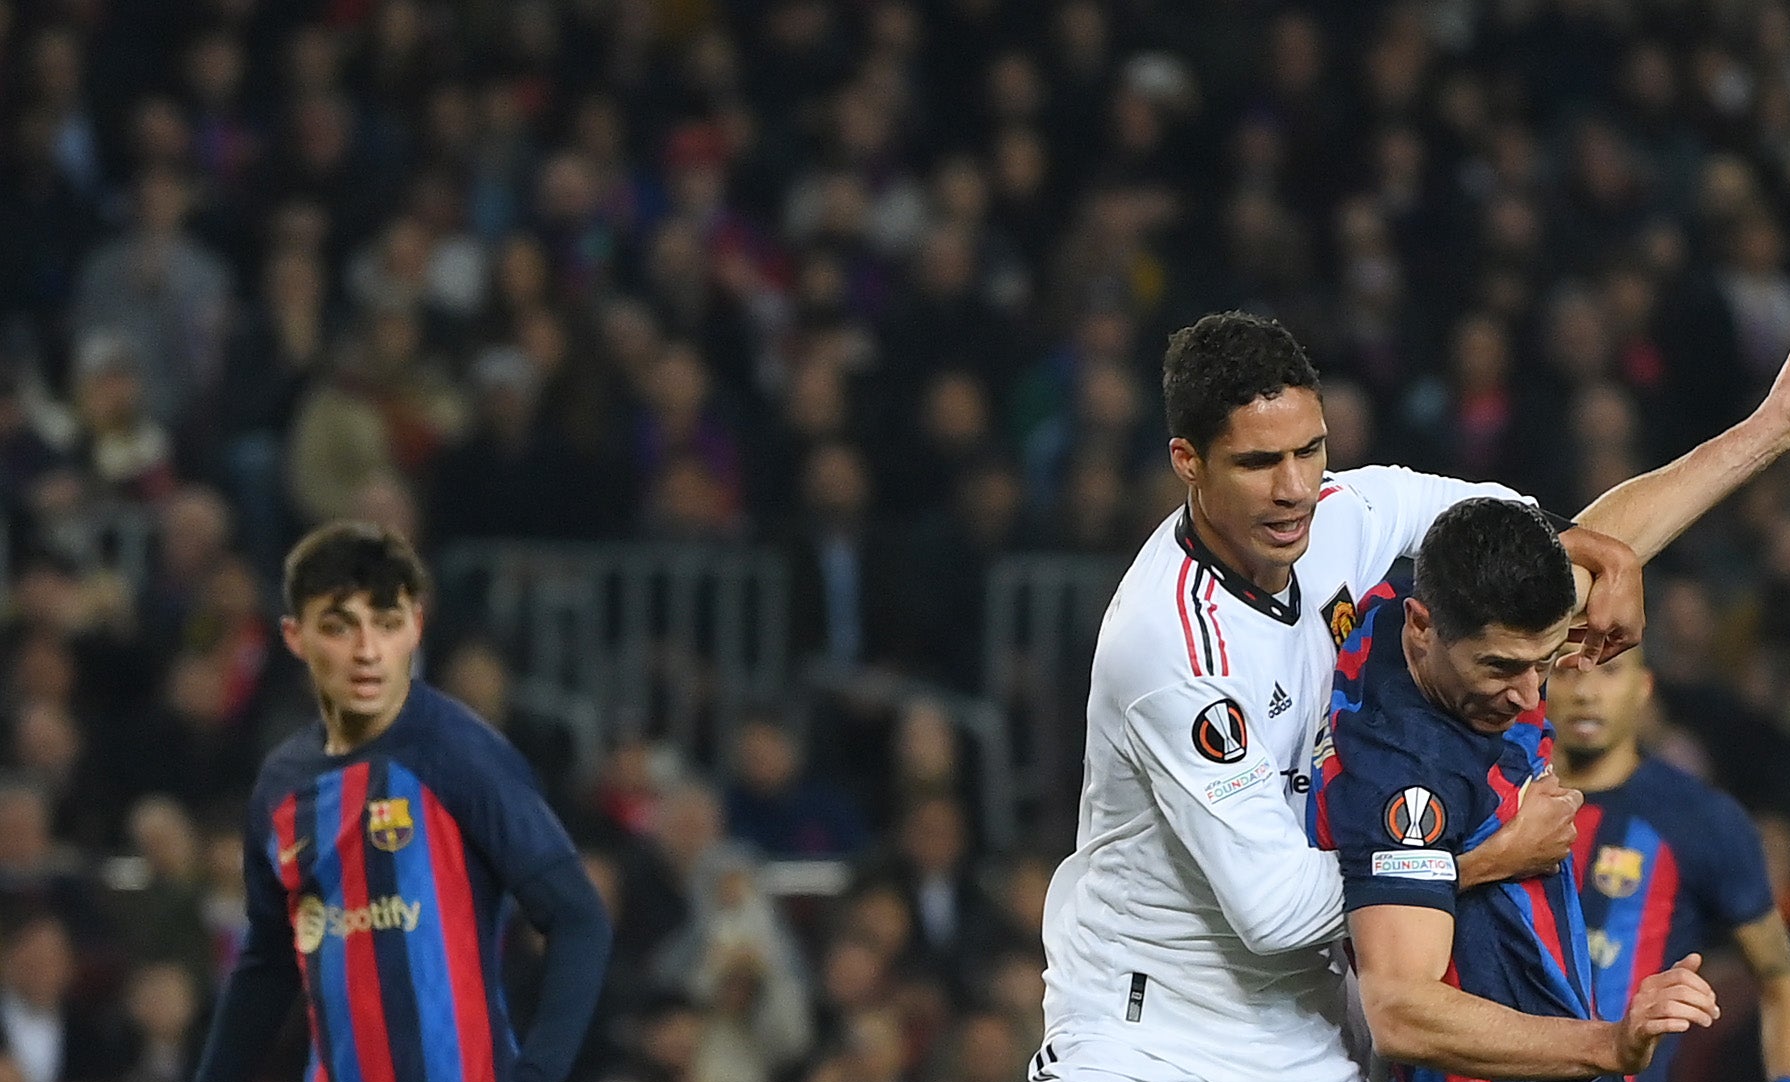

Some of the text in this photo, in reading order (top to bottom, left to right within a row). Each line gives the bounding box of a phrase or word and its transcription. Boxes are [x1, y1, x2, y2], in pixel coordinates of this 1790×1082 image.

[1267, 697, 1293, 719] adidas
[1375, 859, 1453, 872] FOUNDATION
[324, 895, 421, 939] Spotify
